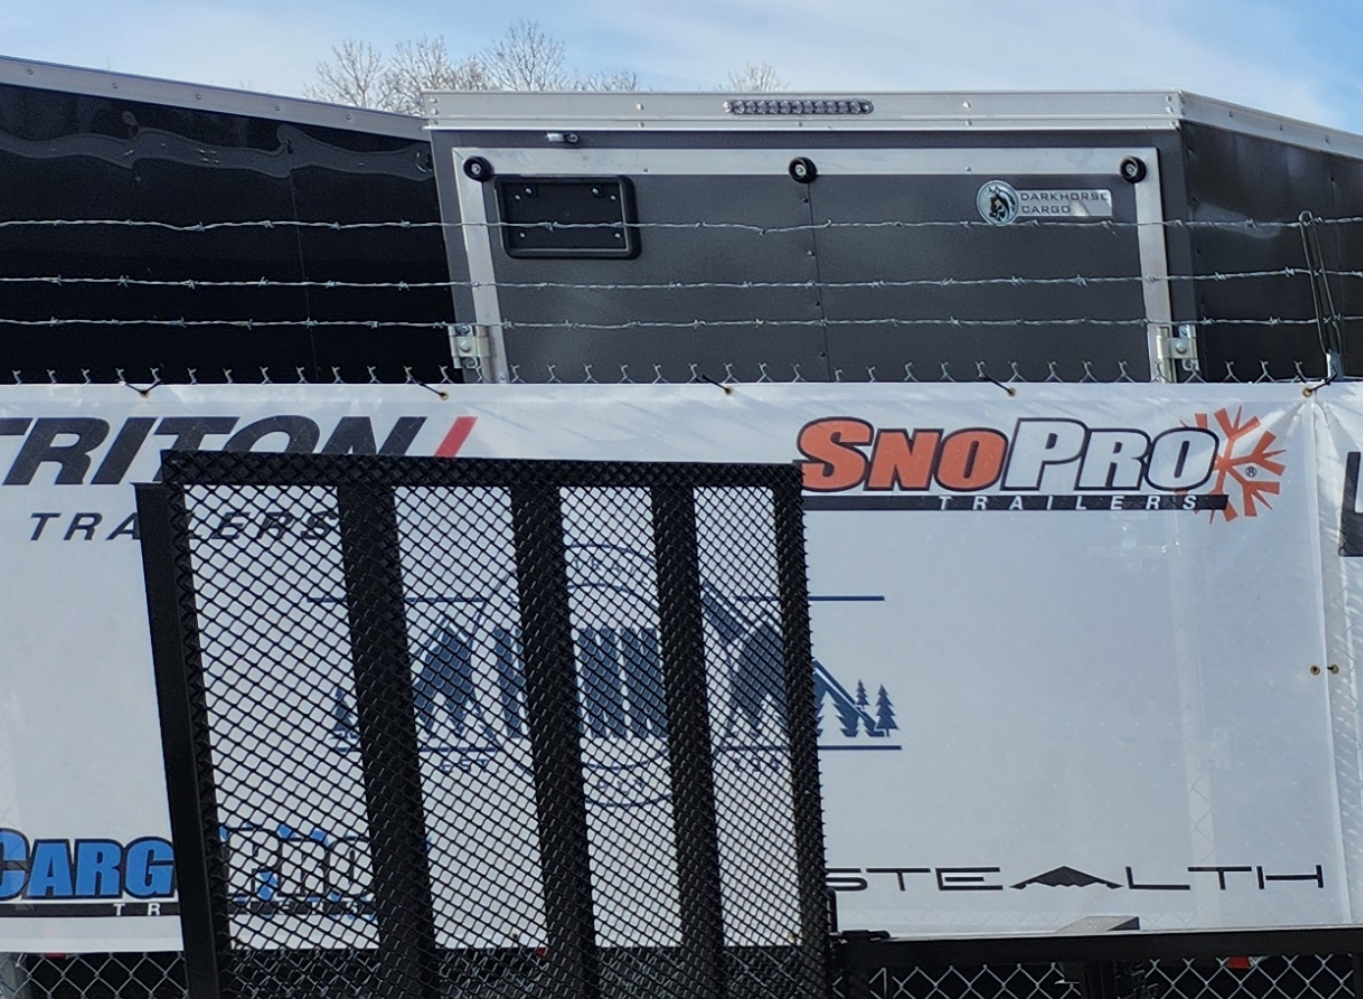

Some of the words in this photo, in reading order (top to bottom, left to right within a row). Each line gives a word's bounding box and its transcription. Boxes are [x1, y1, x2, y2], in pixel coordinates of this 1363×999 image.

[1020, 192, 1109, 201] DARKHORSE
[1021, 205, 1071, 214] CARGO
[0, 415, 427, 485] RITON
[938, 494, 1197, 511] TRAILERS
